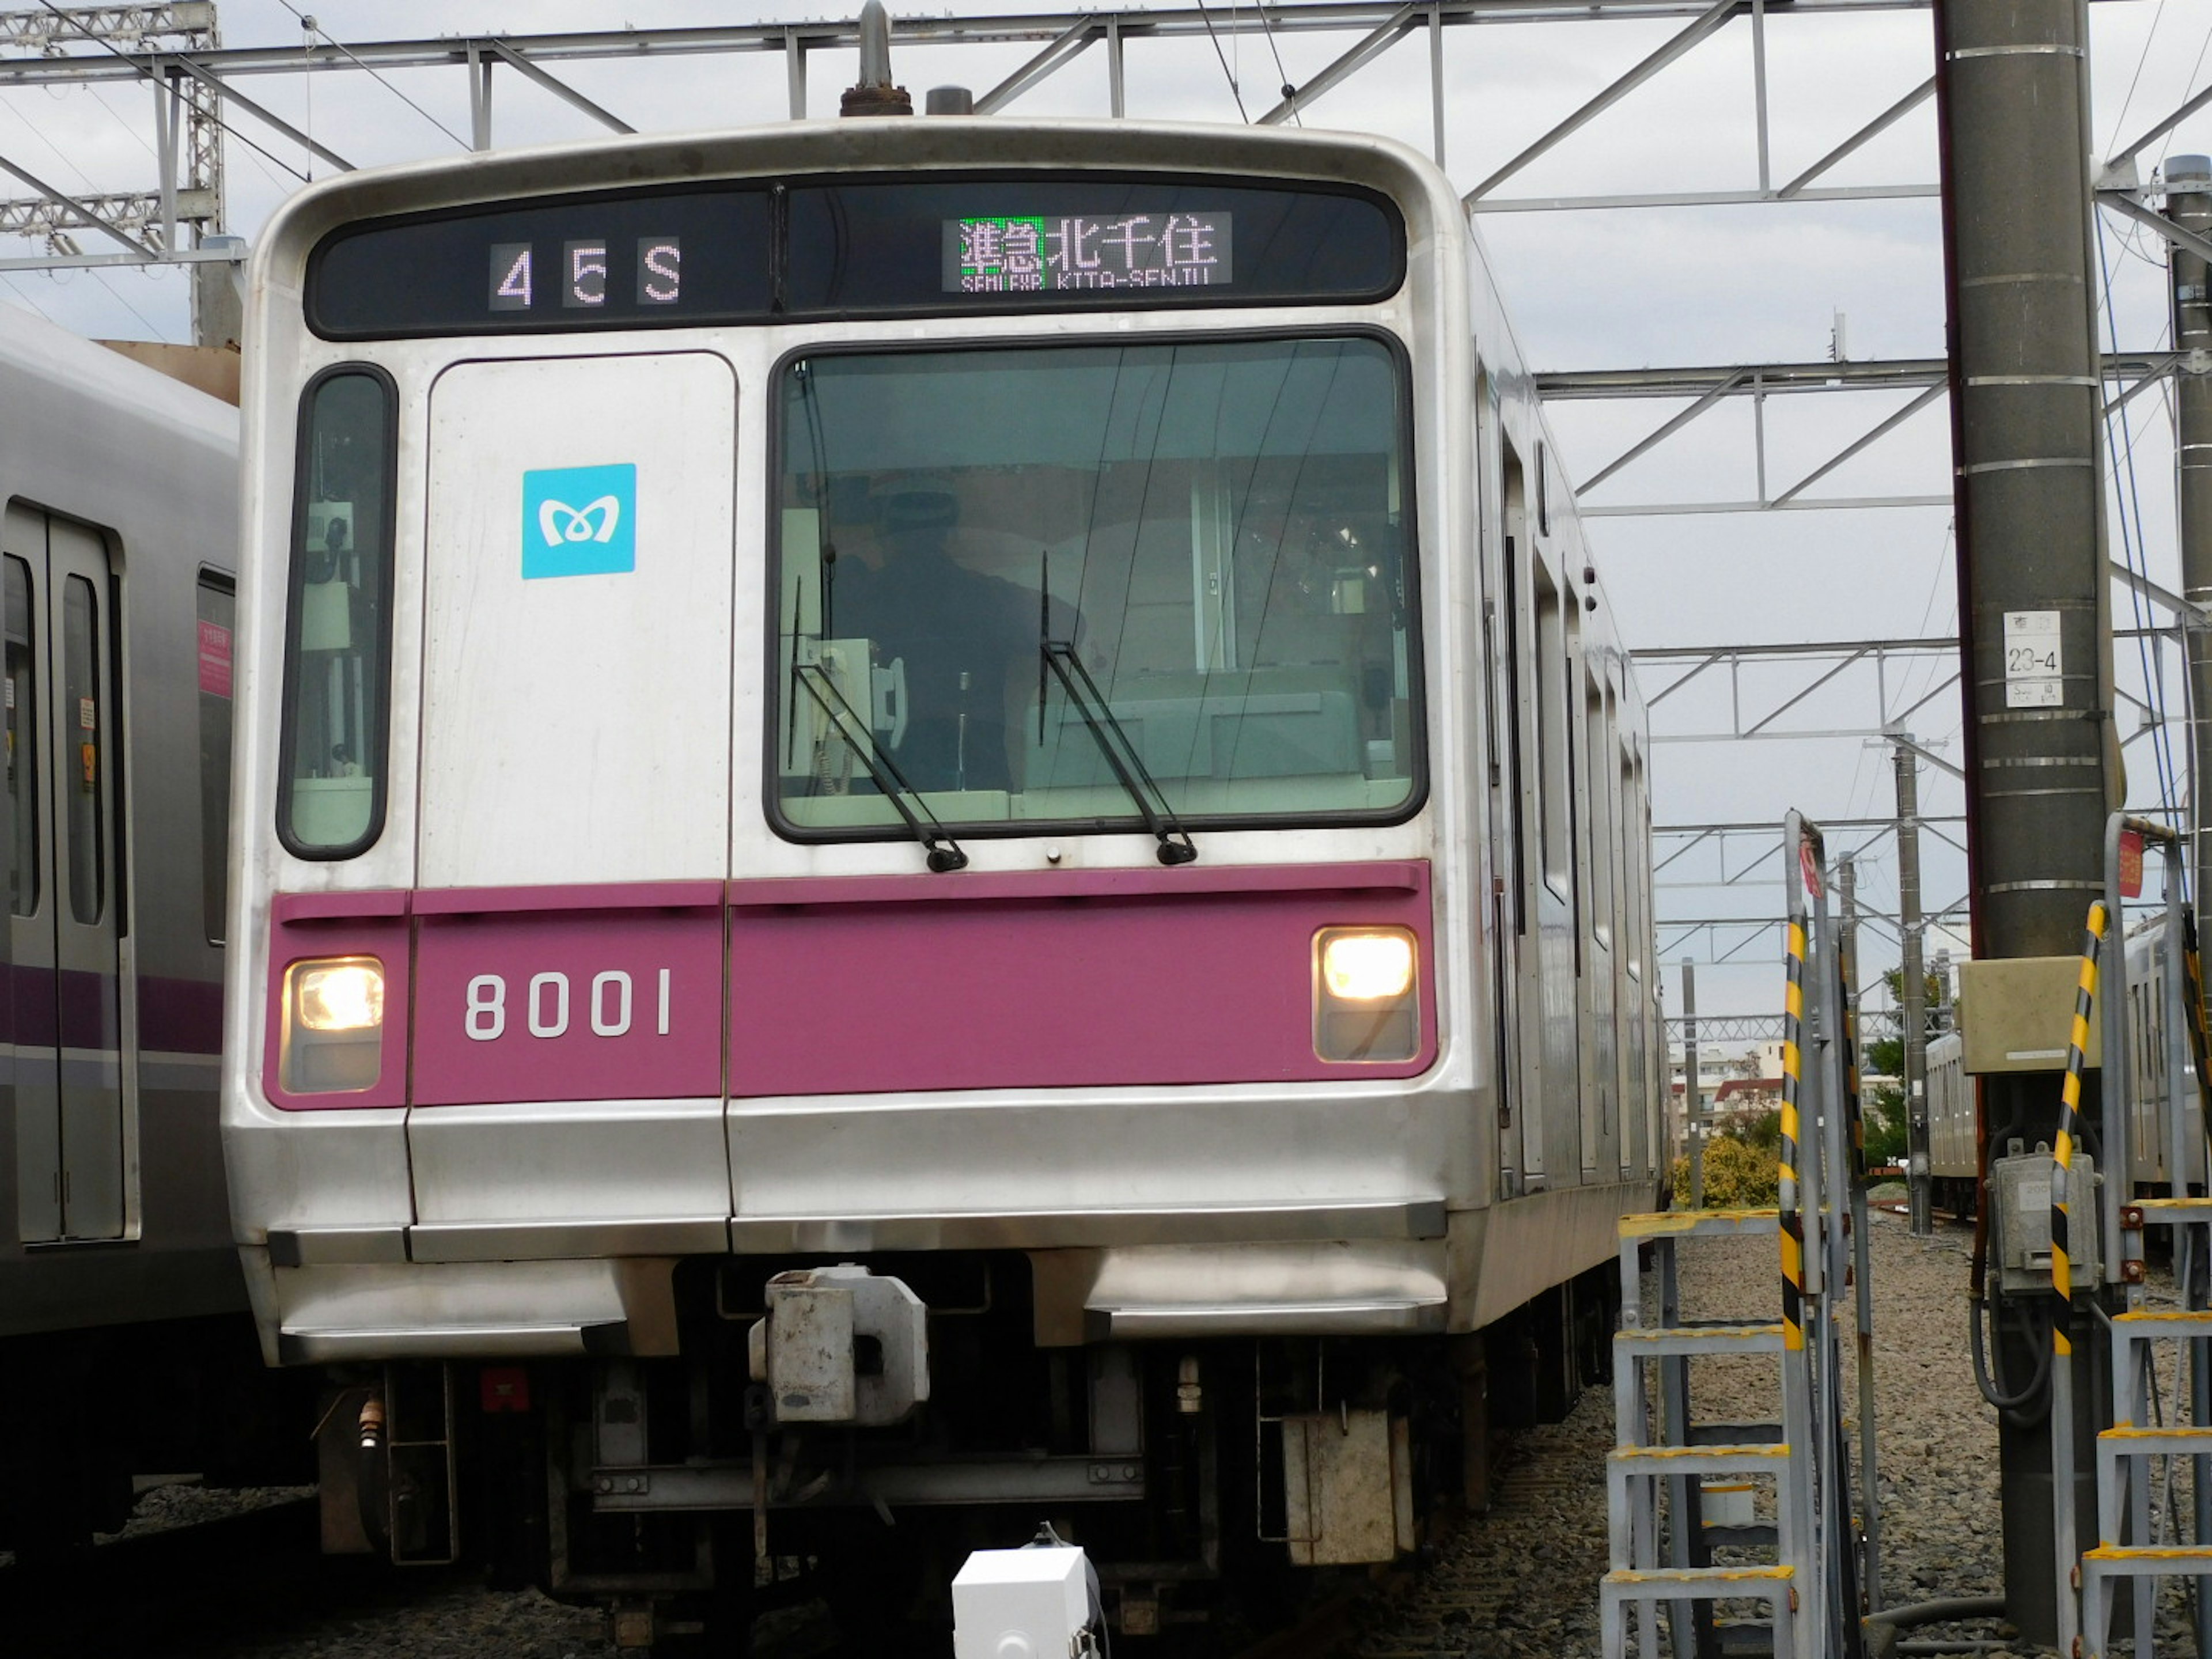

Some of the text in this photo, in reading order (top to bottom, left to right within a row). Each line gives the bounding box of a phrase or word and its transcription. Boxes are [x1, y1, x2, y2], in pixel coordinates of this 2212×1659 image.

[960, 215, 1218, 274] 準急 北千住
[960, 275, 1003, 293] SEMI
[2009, 647, 2057, 672] 23-4
[465, 968, 671, 1041] 8001
